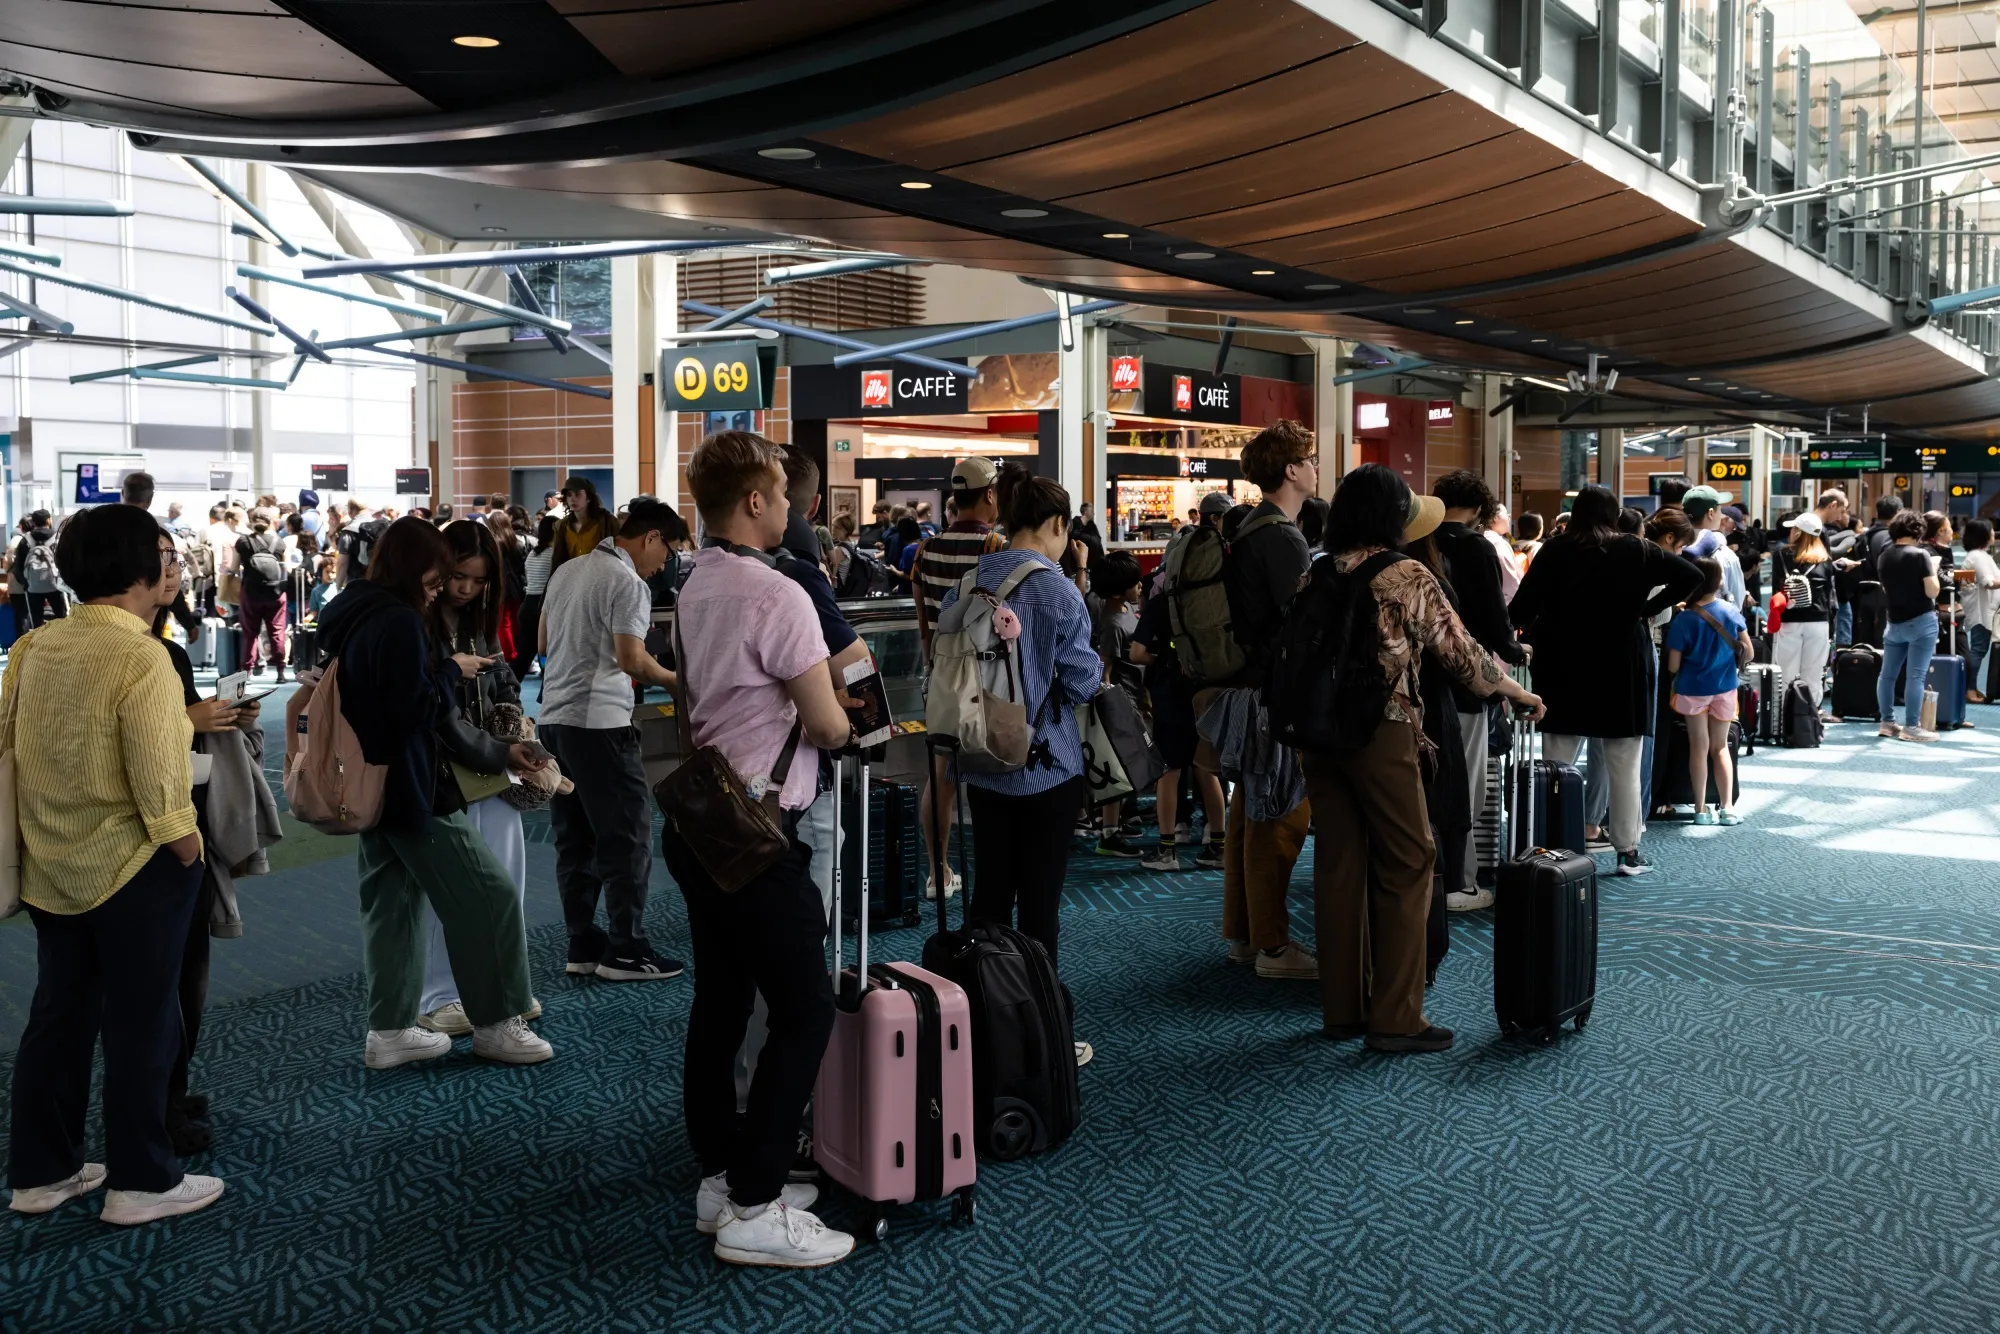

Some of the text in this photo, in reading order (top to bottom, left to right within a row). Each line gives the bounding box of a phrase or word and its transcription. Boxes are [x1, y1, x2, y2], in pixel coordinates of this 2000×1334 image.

[682, 361, 748, 393] D 69
[865, 370, 956, 402] illy CAFFÈ
[1114, 363, 1137, 386] illy
[1177, 382, 1229, 408] illy CAFFÈ
[1189, 459, 1207, 473] CAFFÈ
[1729, 464, 1747, 476] 70
[1963, 487, 1973, 495] 71
